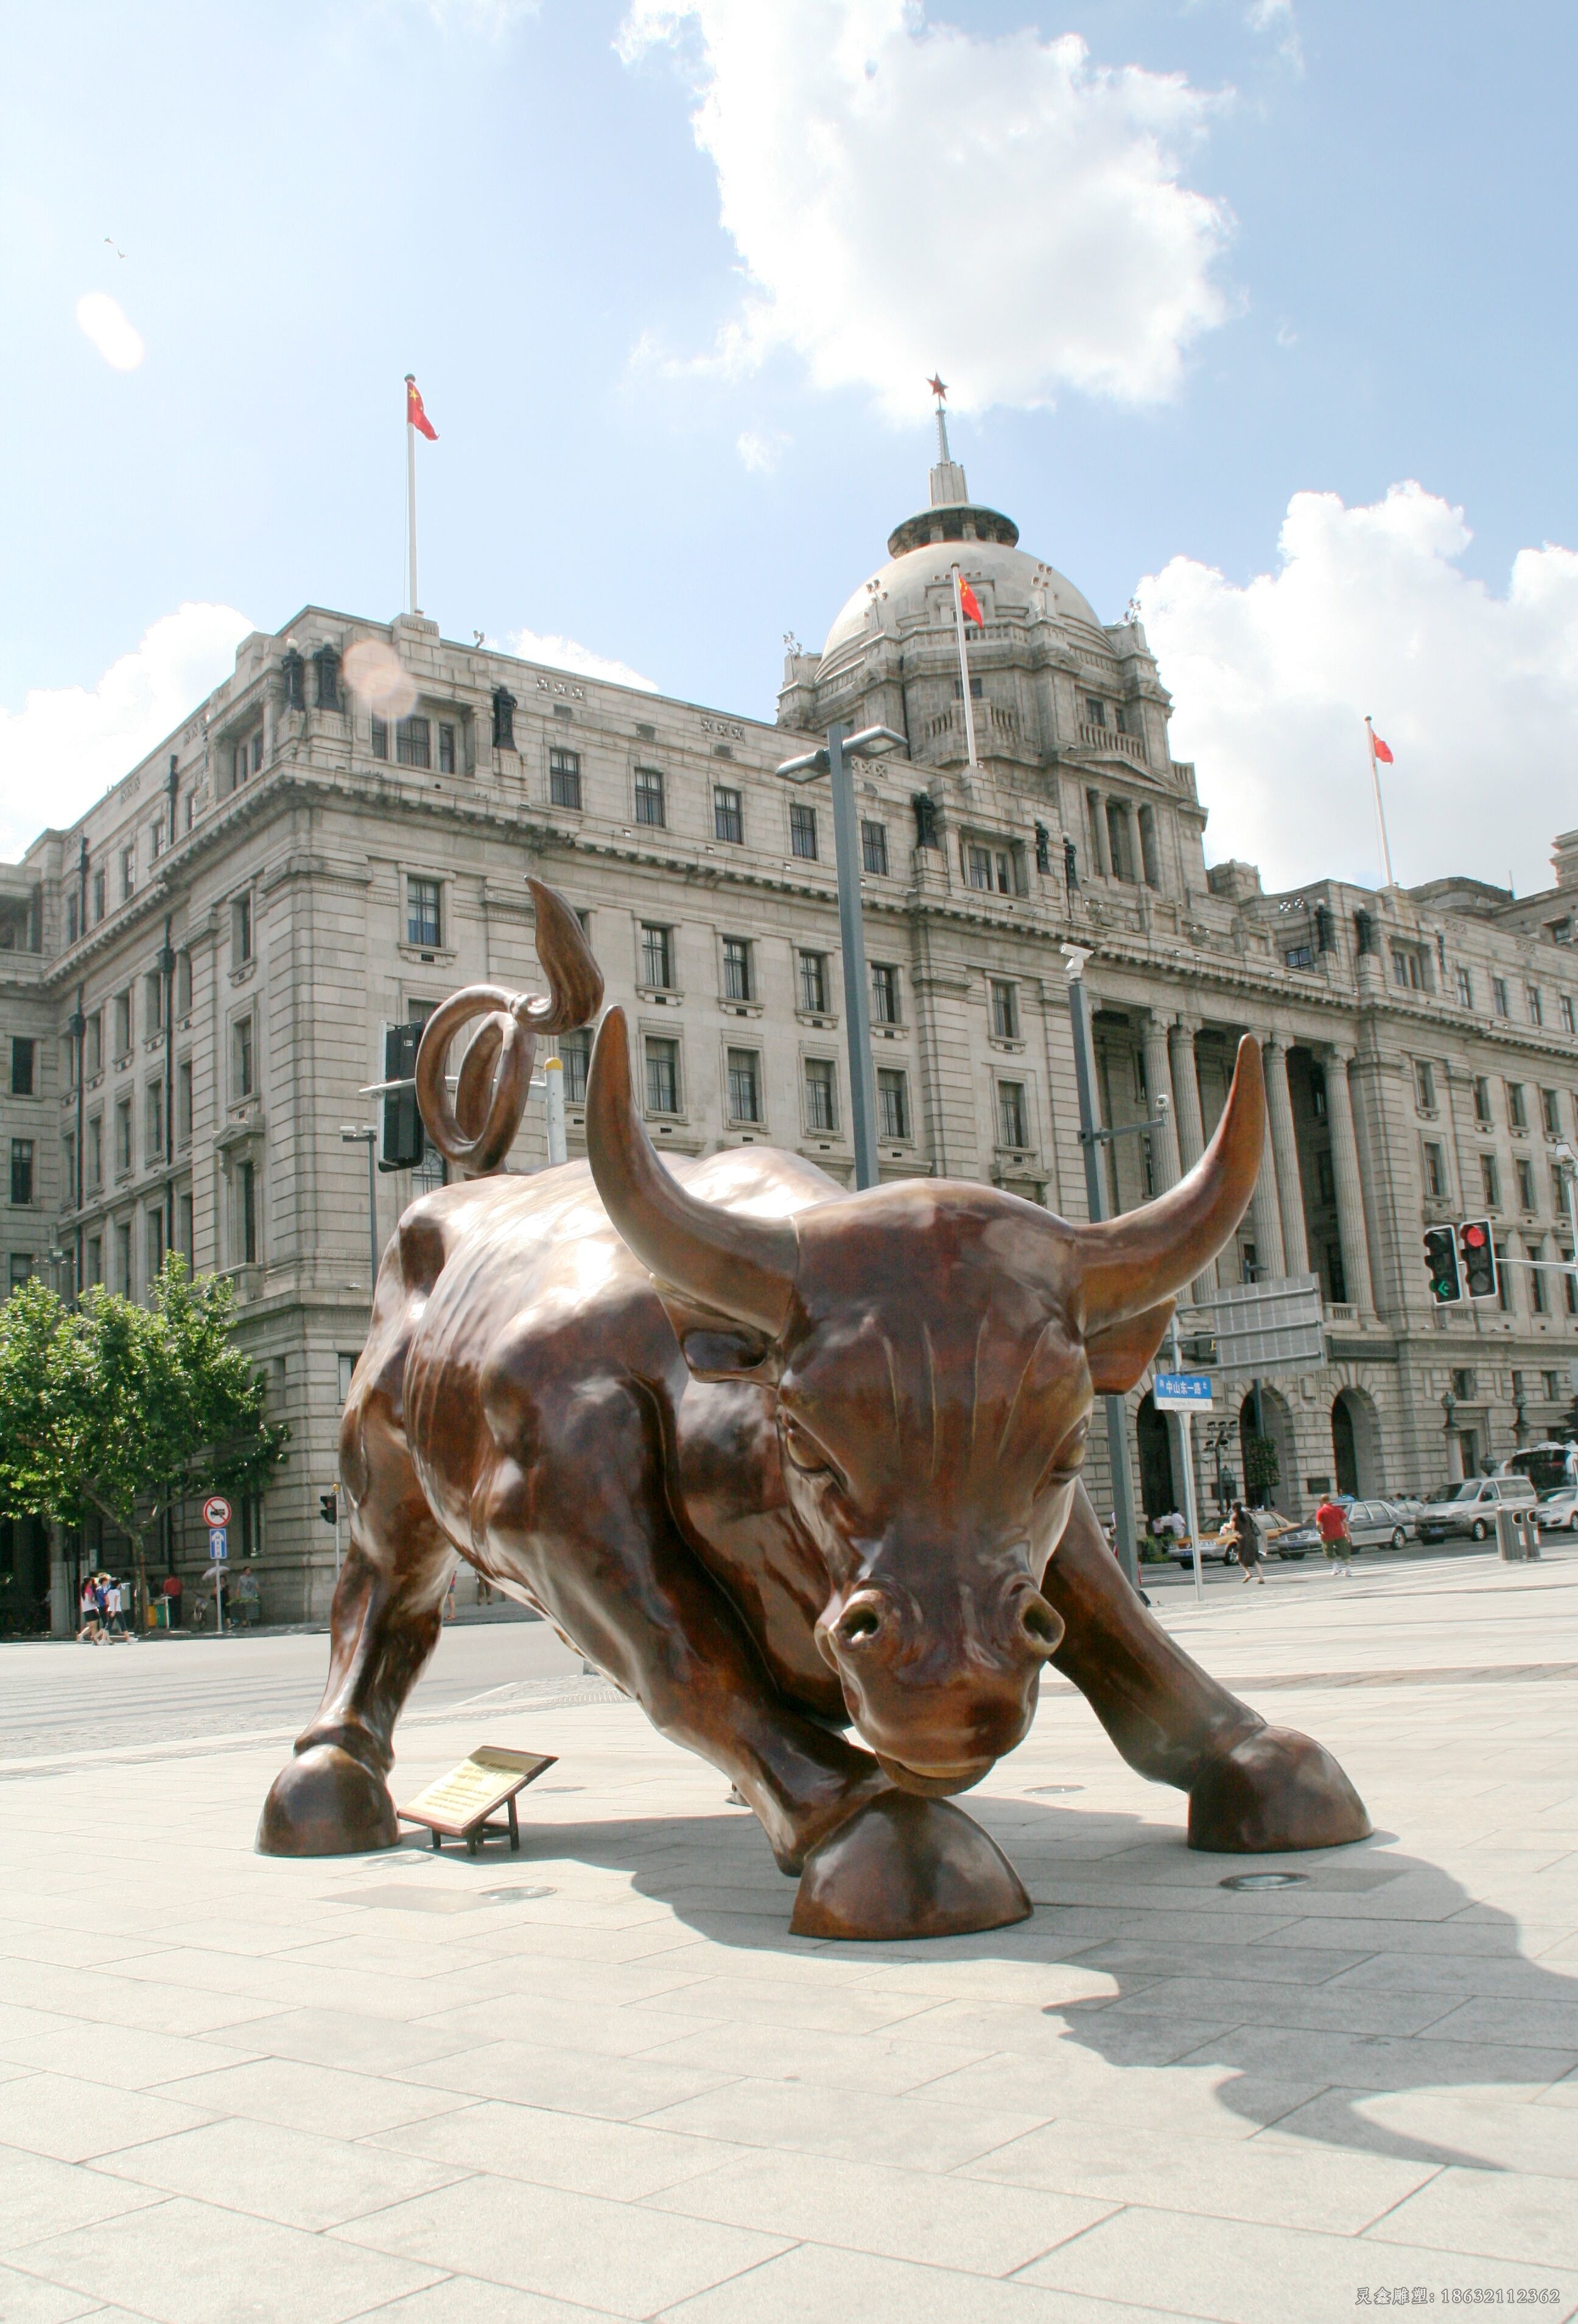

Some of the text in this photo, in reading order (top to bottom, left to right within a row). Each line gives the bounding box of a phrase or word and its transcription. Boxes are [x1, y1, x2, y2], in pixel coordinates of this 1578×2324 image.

[1166, 1381, 1201, 1395] 中山东一路
